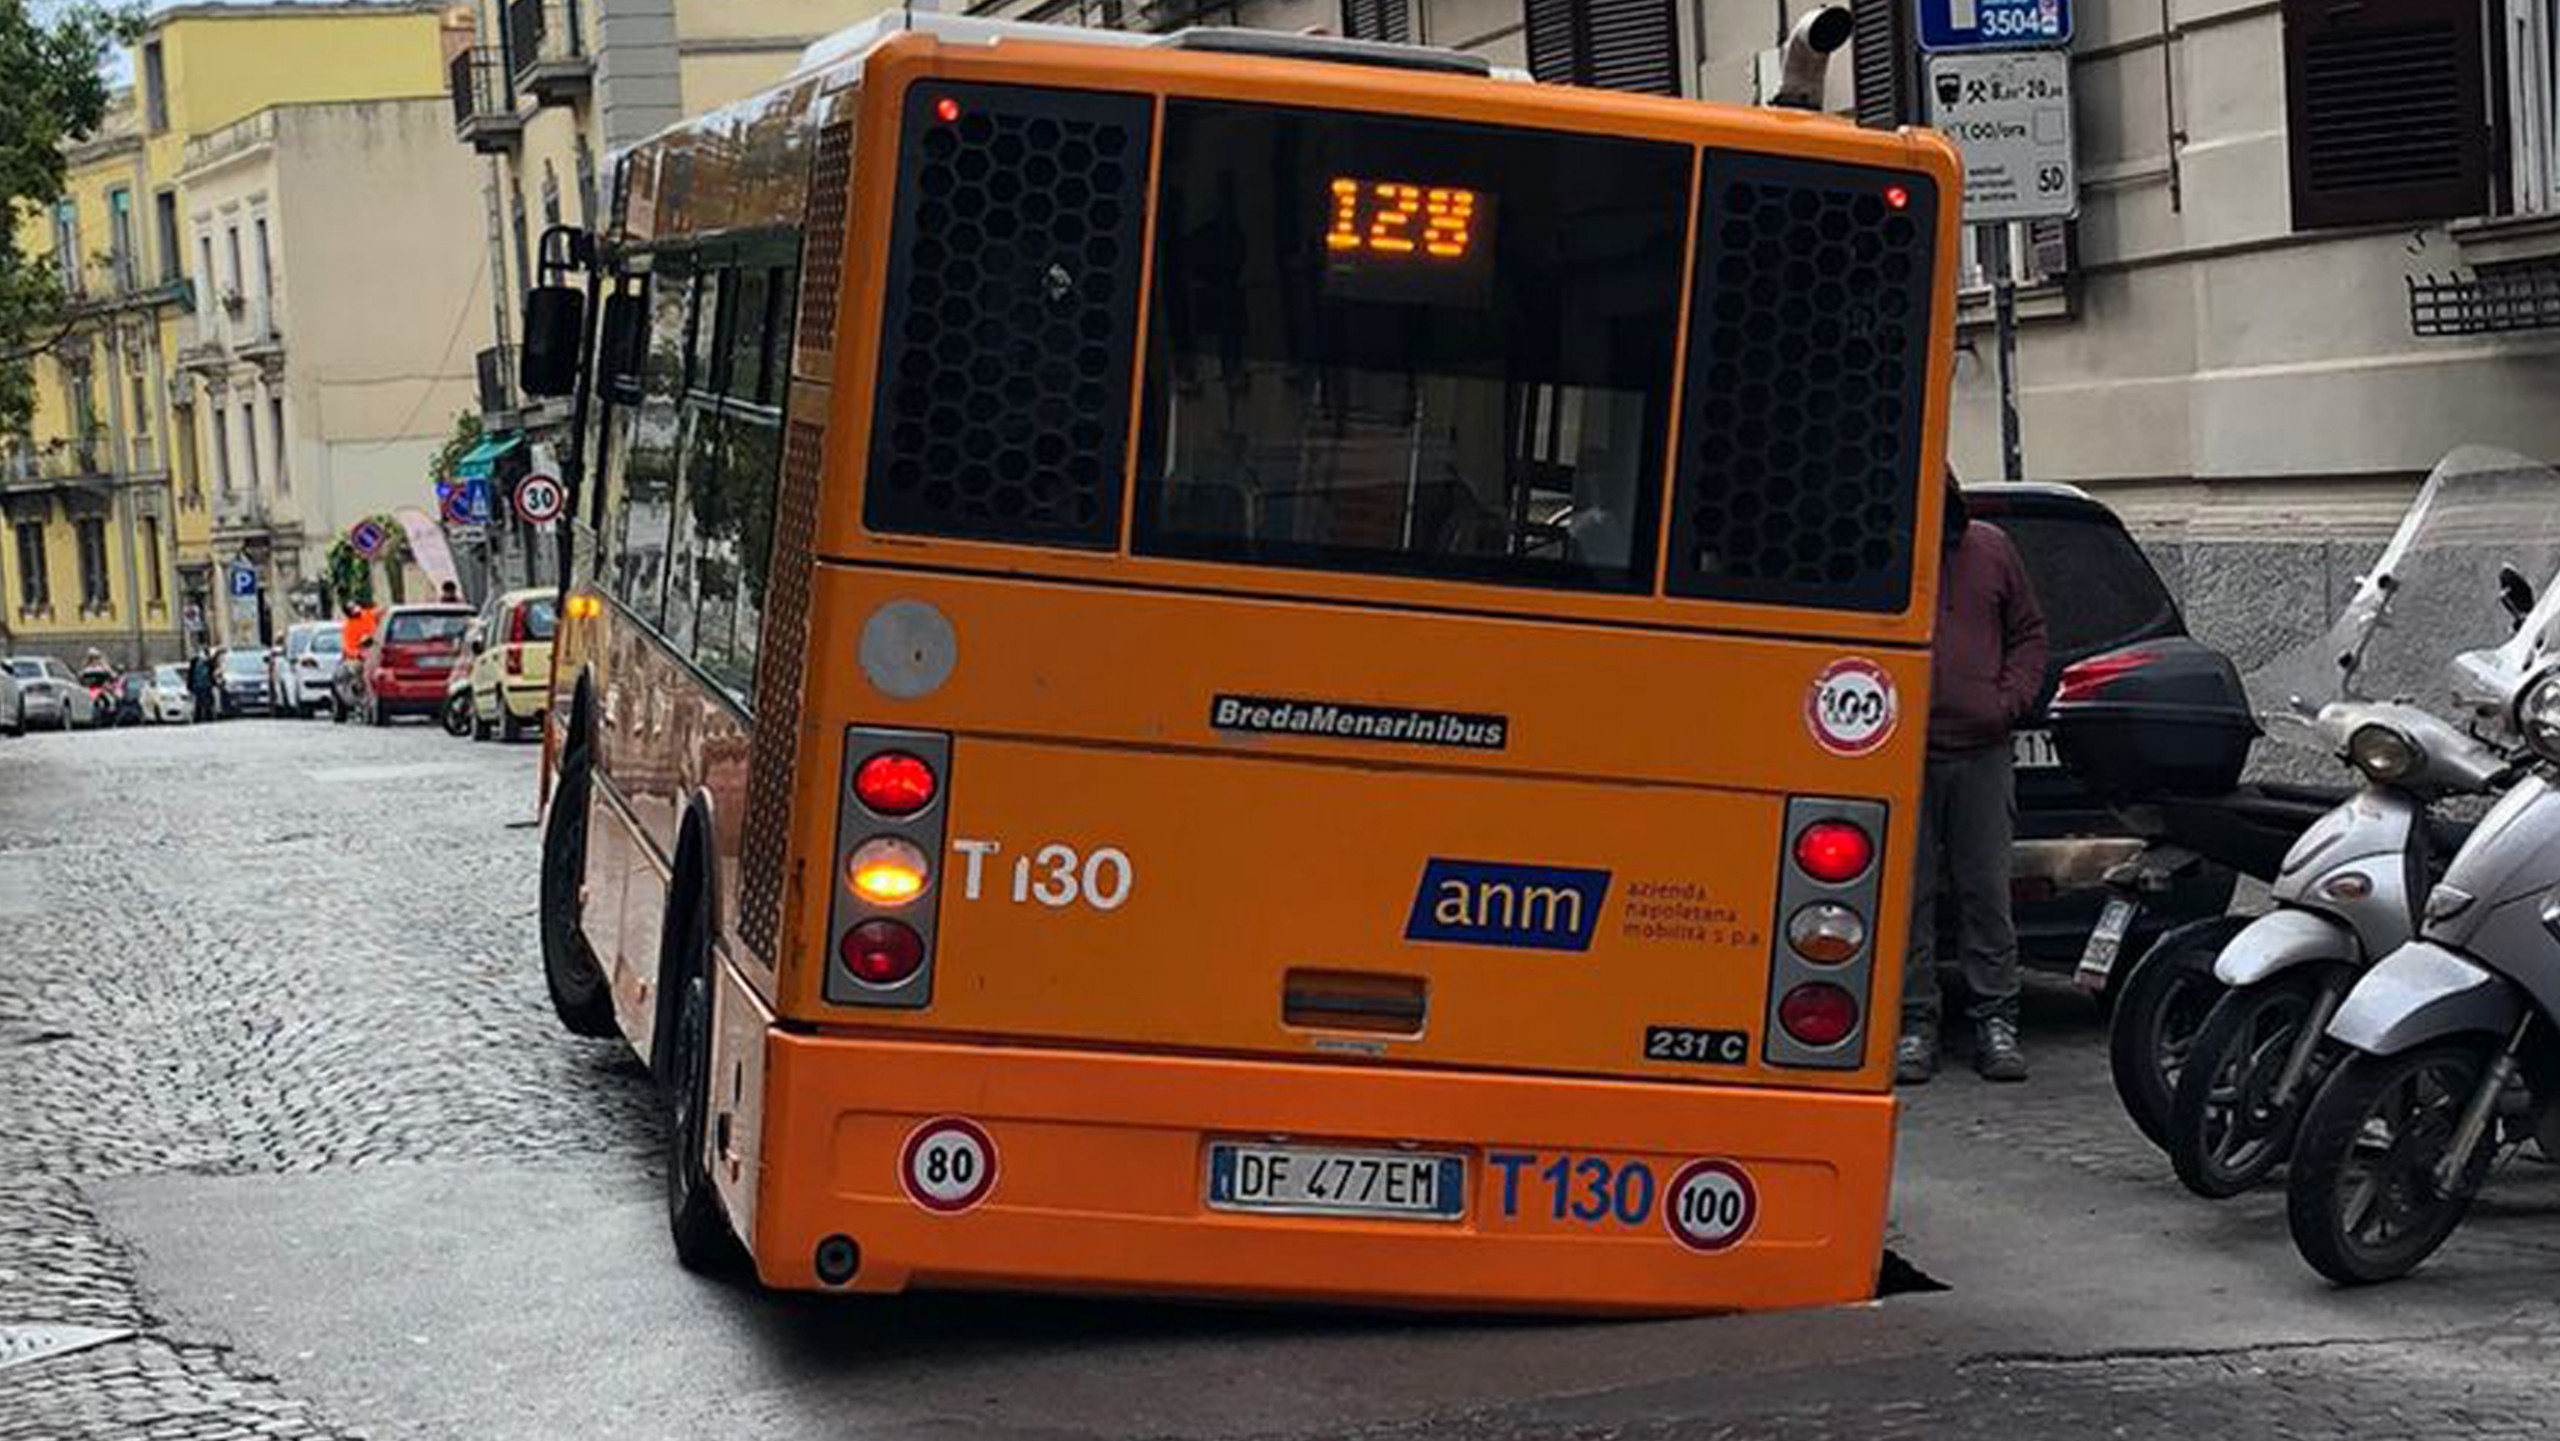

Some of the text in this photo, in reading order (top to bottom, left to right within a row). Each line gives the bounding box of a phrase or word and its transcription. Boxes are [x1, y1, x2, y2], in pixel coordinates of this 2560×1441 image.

[1981, 8, 2038, 36] 3504
[1326, 178, 1474, 256] 128
[527, 486, 555, 510] 30
[236, 570, 253, 593] P
[1215, 699, 1504, 745] BredaMenarinibus
[1822, 686, 1883, 726] 100
[1434, 878, 1582, 934] anm
[1650, 1031, 1744, 1060] 231 C
[927, 1145, 974, 1185] 80
[1240, 1154, 1434, 1205] DF 477EM
[1489, 1154, 1742, 1227] T130 100
